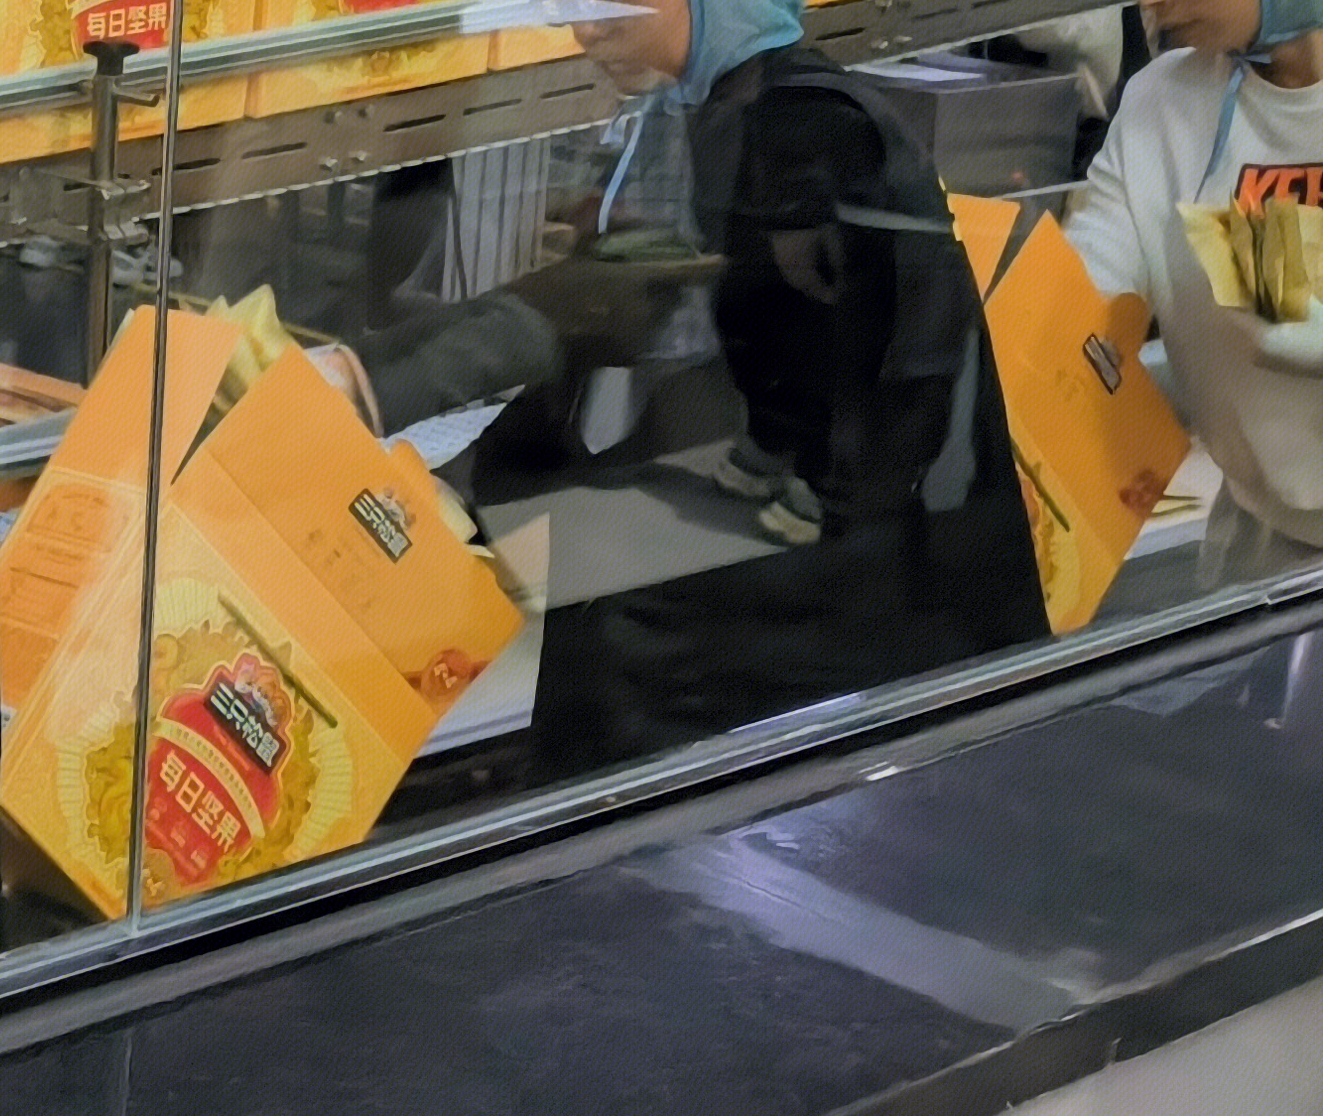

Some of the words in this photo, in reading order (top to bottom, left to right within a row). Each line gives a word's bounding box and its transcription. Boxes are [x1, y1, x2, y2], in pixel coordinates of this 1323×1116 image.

[87, 2, 168, 40] 每日坚果
[210, 682, 280, 768] 三只松鼠
[159, 749, 242, 853] 每日坚果
